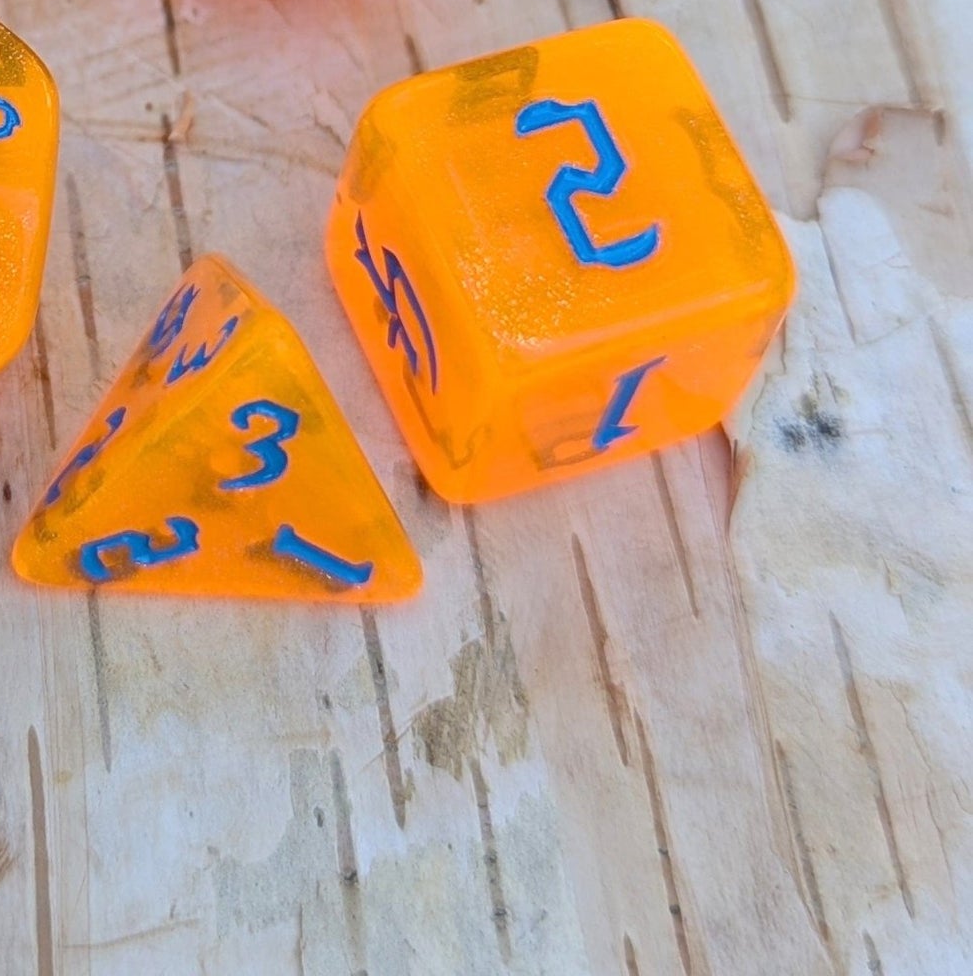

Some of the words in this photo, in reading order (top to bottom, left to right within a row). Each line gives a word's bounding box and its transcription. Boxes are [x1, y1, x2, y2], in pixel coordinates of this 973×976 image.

[515, 99, 661, 270] 2
[355, 209, 438, 396] 4
[220, 398, 301, 492] 3
[592, 354, 668, 452] 1
[79, 515, 201, 582] 2
[271, 523, 375, 586] 1
